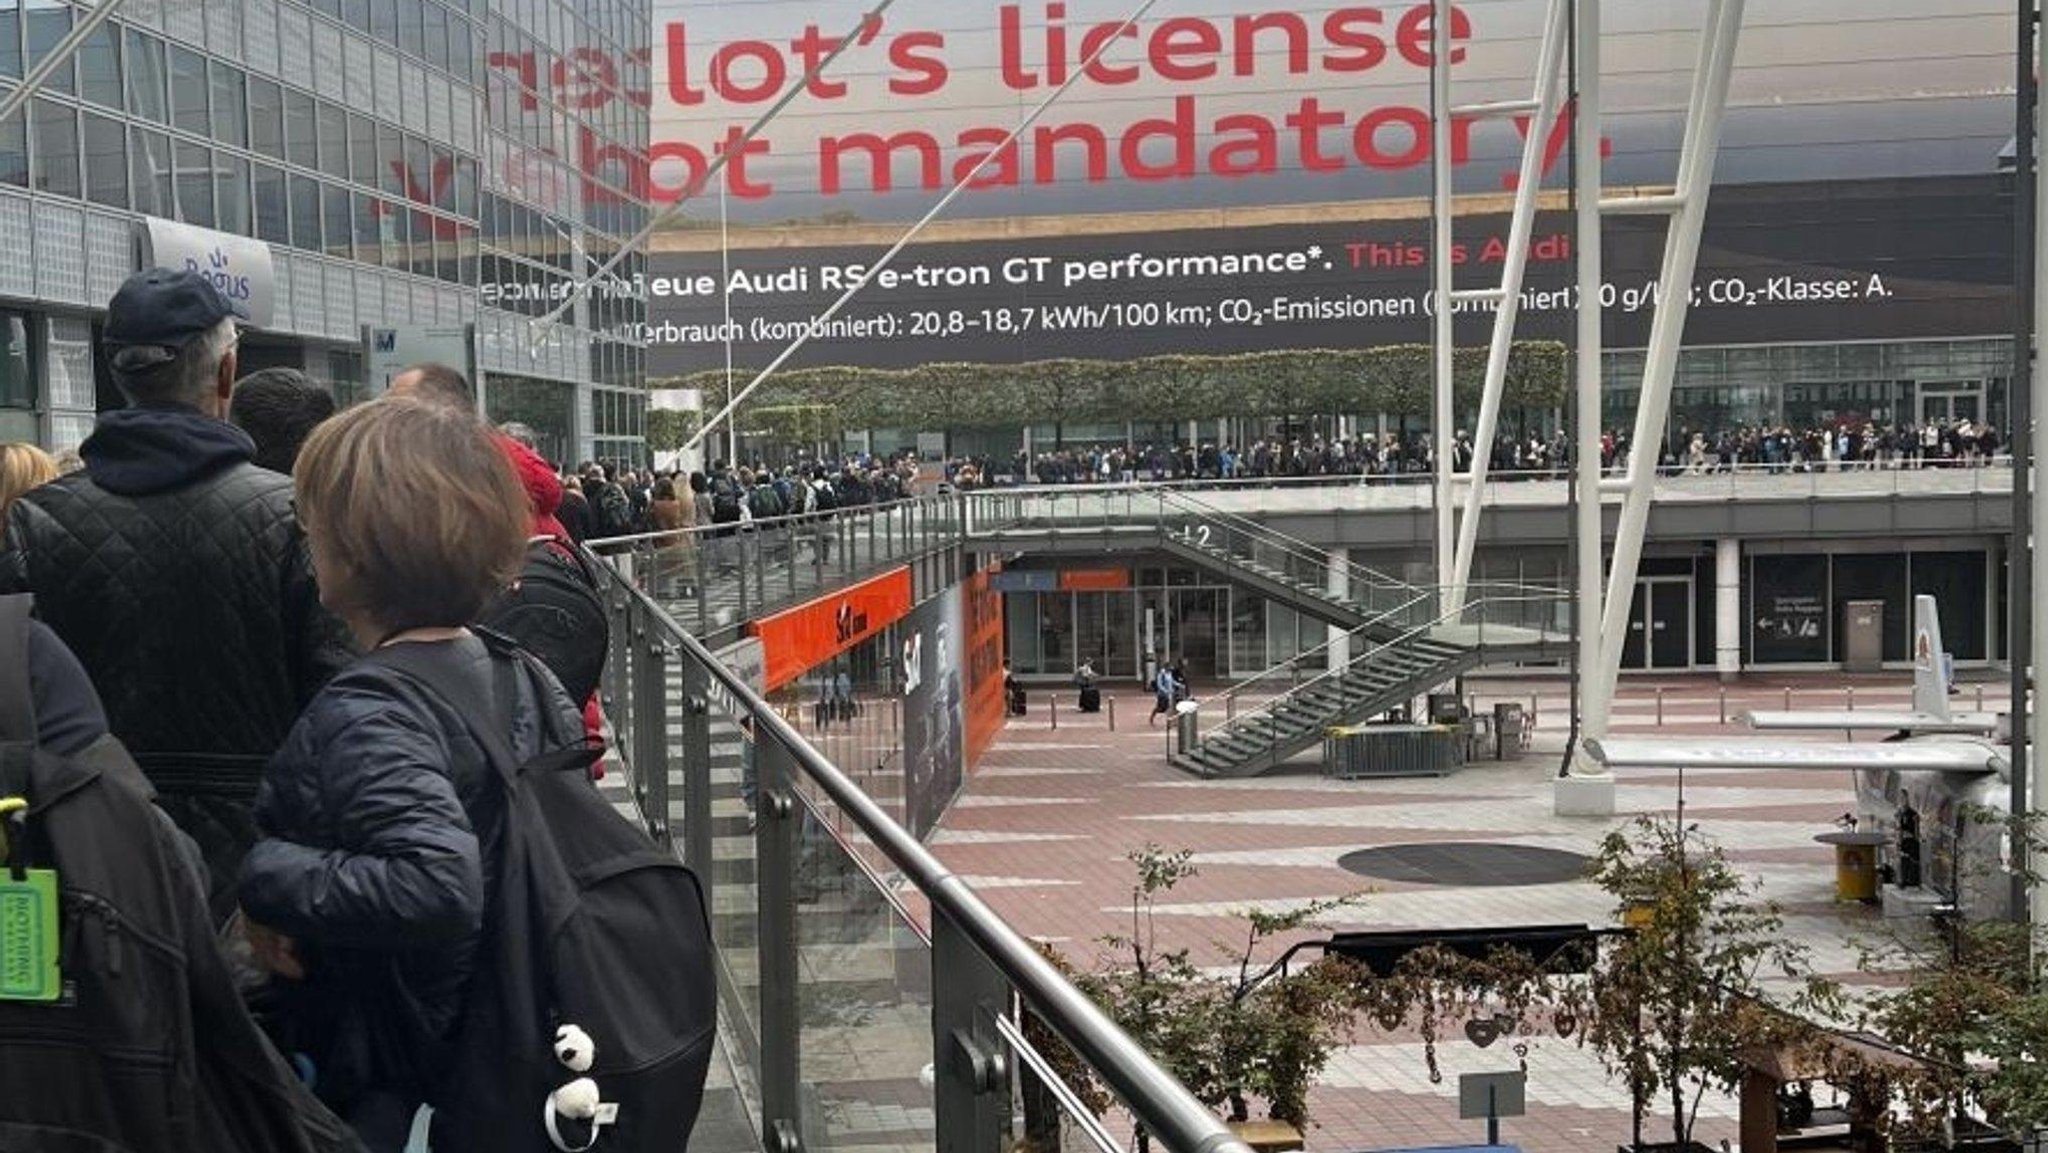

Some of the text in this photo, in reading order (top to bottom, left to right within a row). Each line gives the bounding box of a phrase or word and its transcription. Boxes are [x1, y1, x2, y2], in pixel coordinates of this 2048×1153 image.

[1000, 3, 1472, 90] license
[819, 95, 1612, 194] mandatory.
[651, 275, 715, 297] eue
[728, 268, 807, 292] Audi
[821, 265, 868, 290] RS
[878, 264, 990, 288] e-tron
[1003, 257, 1051, 284] GT
[1346, 242, 1425, 268] This
[1479, 233, 1569, 264] Adi
[648, 318, 744, 344] erbrauch
[751, 311, 903, 341] (kombiniert):
[910, 309, 1034, 338] 20,8–18,7
[1041, 302, 1158, 330] kWh/100
[1166, 302, 1211, 327] km;
[1219, 295, 1415, 326] CO₂-Emissionen
[1600, 284, 1615, 307] 0
[1709, 276, 1858, 305] CO₂-Klasse:
[1866, 273, 1893, 297] A.
